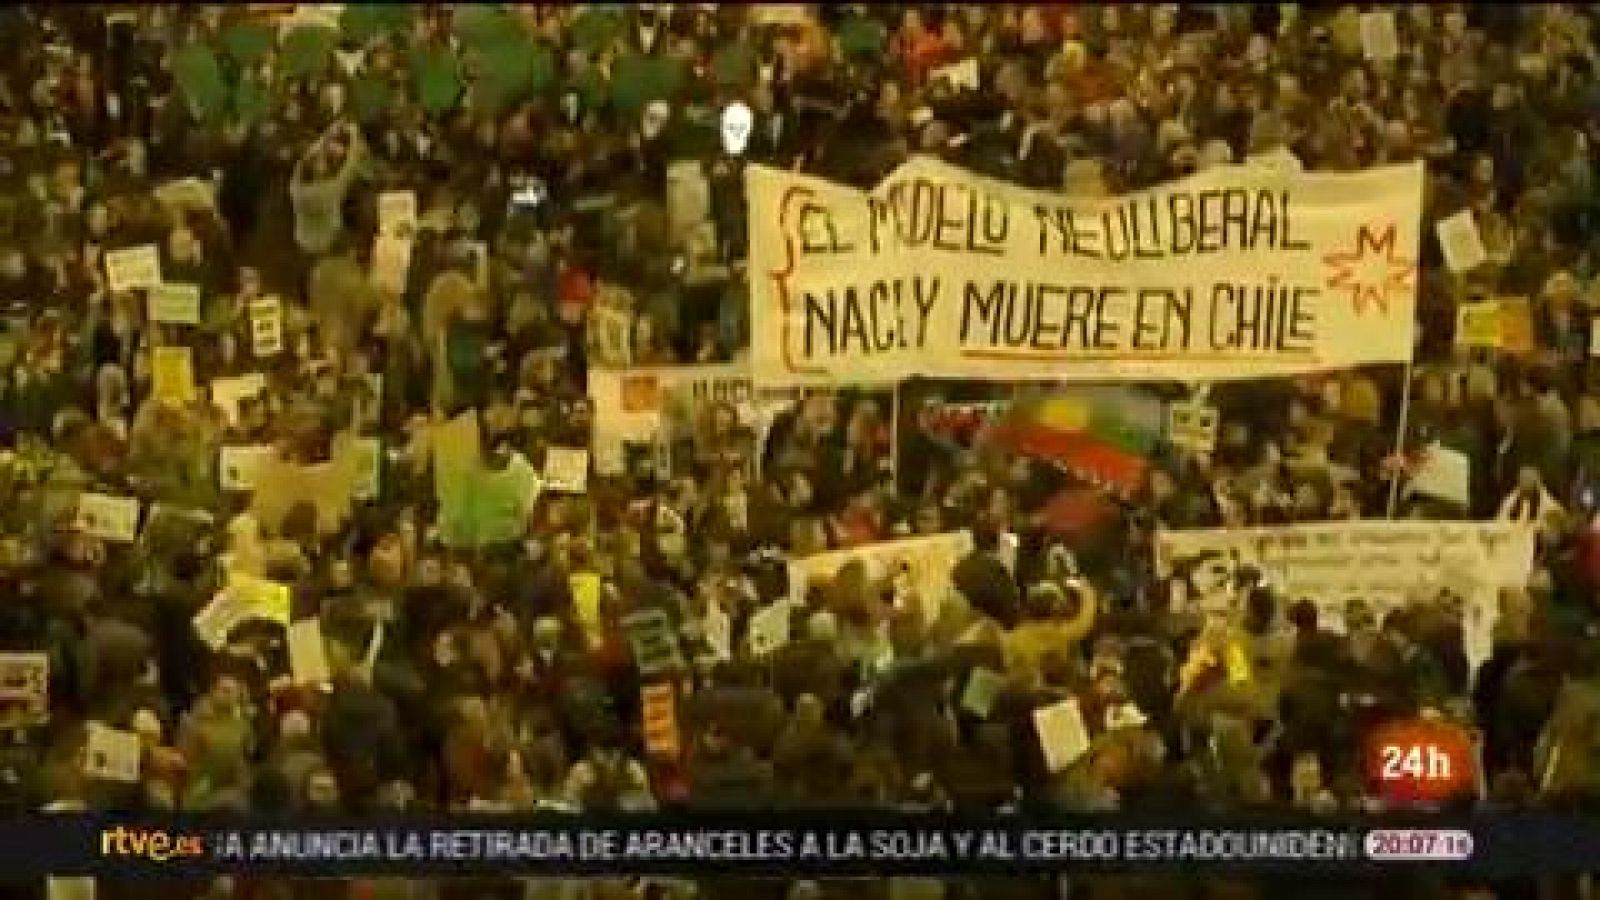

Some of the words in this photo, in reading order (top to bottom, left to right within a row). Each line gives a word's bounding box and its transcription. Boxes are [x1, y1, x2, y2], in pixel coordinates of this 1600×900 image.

[800, 203, 854, 253] EL
[958, 279, 1128, 350] MUERE
[1133, 286, 1194, 351] EN
[1209, 276, 1322, 353] CHILE
